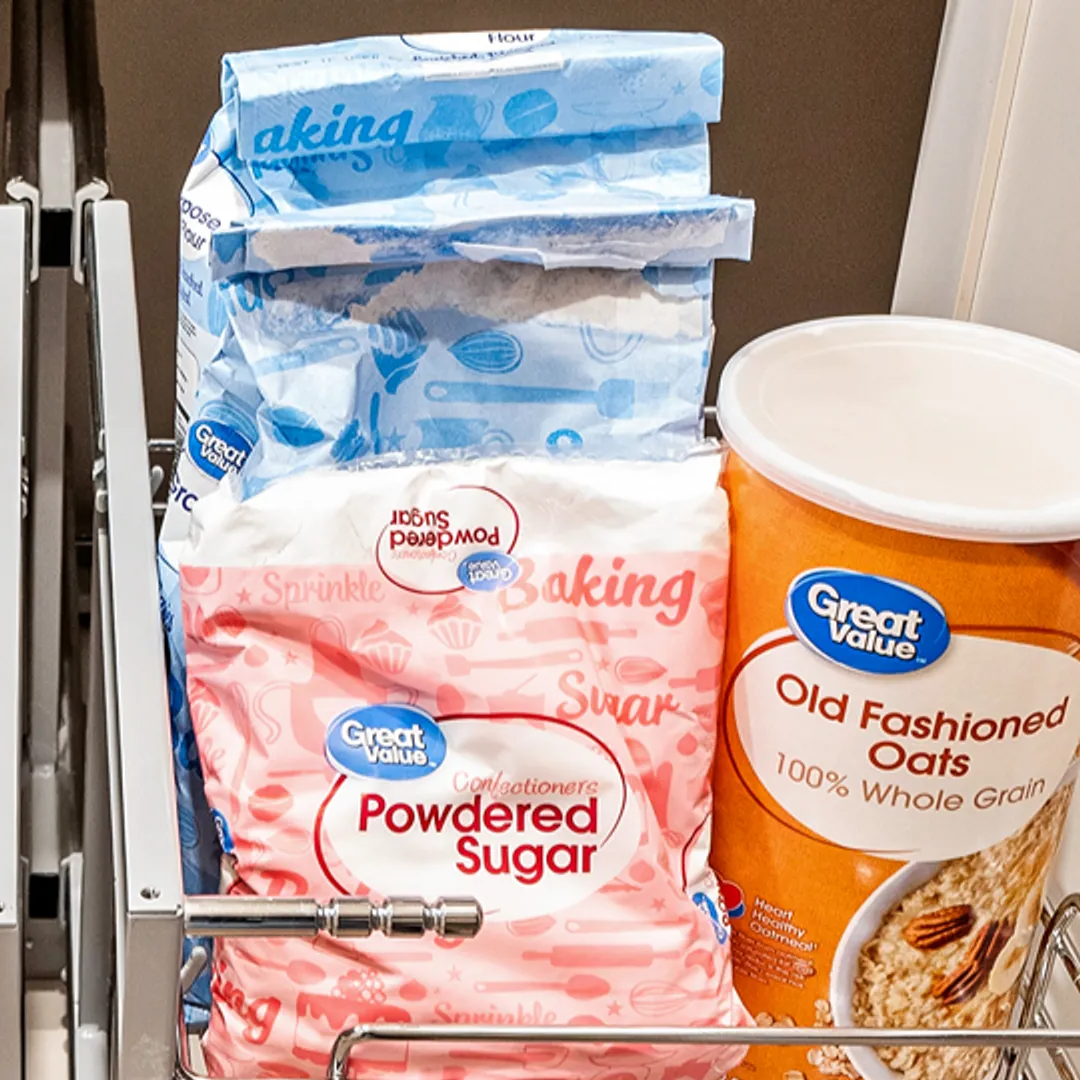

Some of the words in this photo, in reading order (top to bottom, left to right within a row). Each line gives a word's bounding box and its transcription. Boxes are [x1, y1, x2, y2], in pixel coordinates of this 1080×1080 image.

[196, 424, 248, 468] Great
[390, 507, 450, 530] Sugar
[390, 526, 500, 550] Powdered
[262, 569, 387, 610] Sprinkle
[497, 554, 696, 627] Baking
[807, 581, 924, 641] Great
[827, 617, 917, 661] Value
[776, 673, 850, 724] Old
[859, 695, 1070, 742] Fashioned
[341, 719, 426, 751] Great
[366, 745, 429, 767] Value
[868, 740, 971, 778] Oats
[775, 751, 850, 798] 100%
[861, 779, 964, 812] Whole
[973, 777, 1046, 810] Grain
[358, 792, 598, 835] Powdered
[456, 836, 598, 885] Sugar
